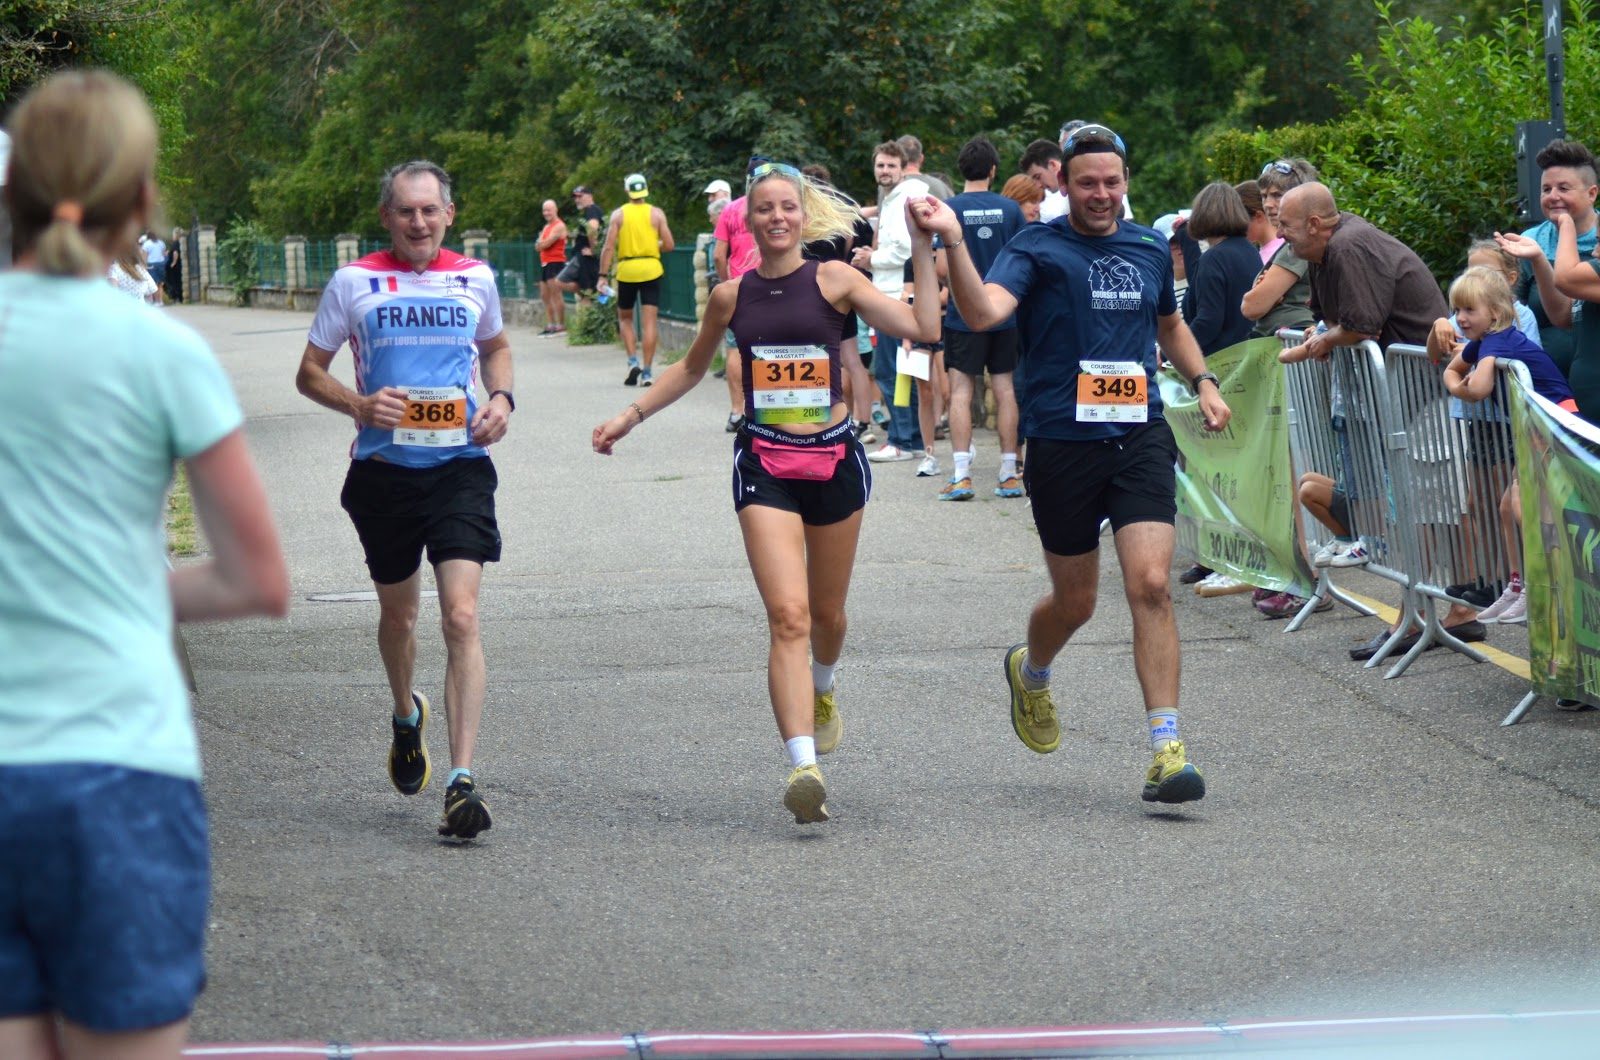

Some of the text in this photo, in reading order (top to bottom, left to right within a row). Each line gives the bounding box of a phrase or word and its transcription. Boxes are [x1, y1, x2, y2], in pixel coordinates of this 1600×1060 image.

[1092, 291, 1142, 300] COURSES NATURE
[1092, 299, 1142, 311] MAGSTATT
[376, 306, 468, 329] FRANCIS
[394, 336, 418, 346] LOUIS
[419, 335, 456, 346] RUNNING
[766, 362, 816, 382] 312
[1092, 377, 1137, 398] 349
[409, 402, 456, 423] 368
[747, 424, 816, 444] UNDER ARMOUR
[822, 423, 849, 441] UNDER
